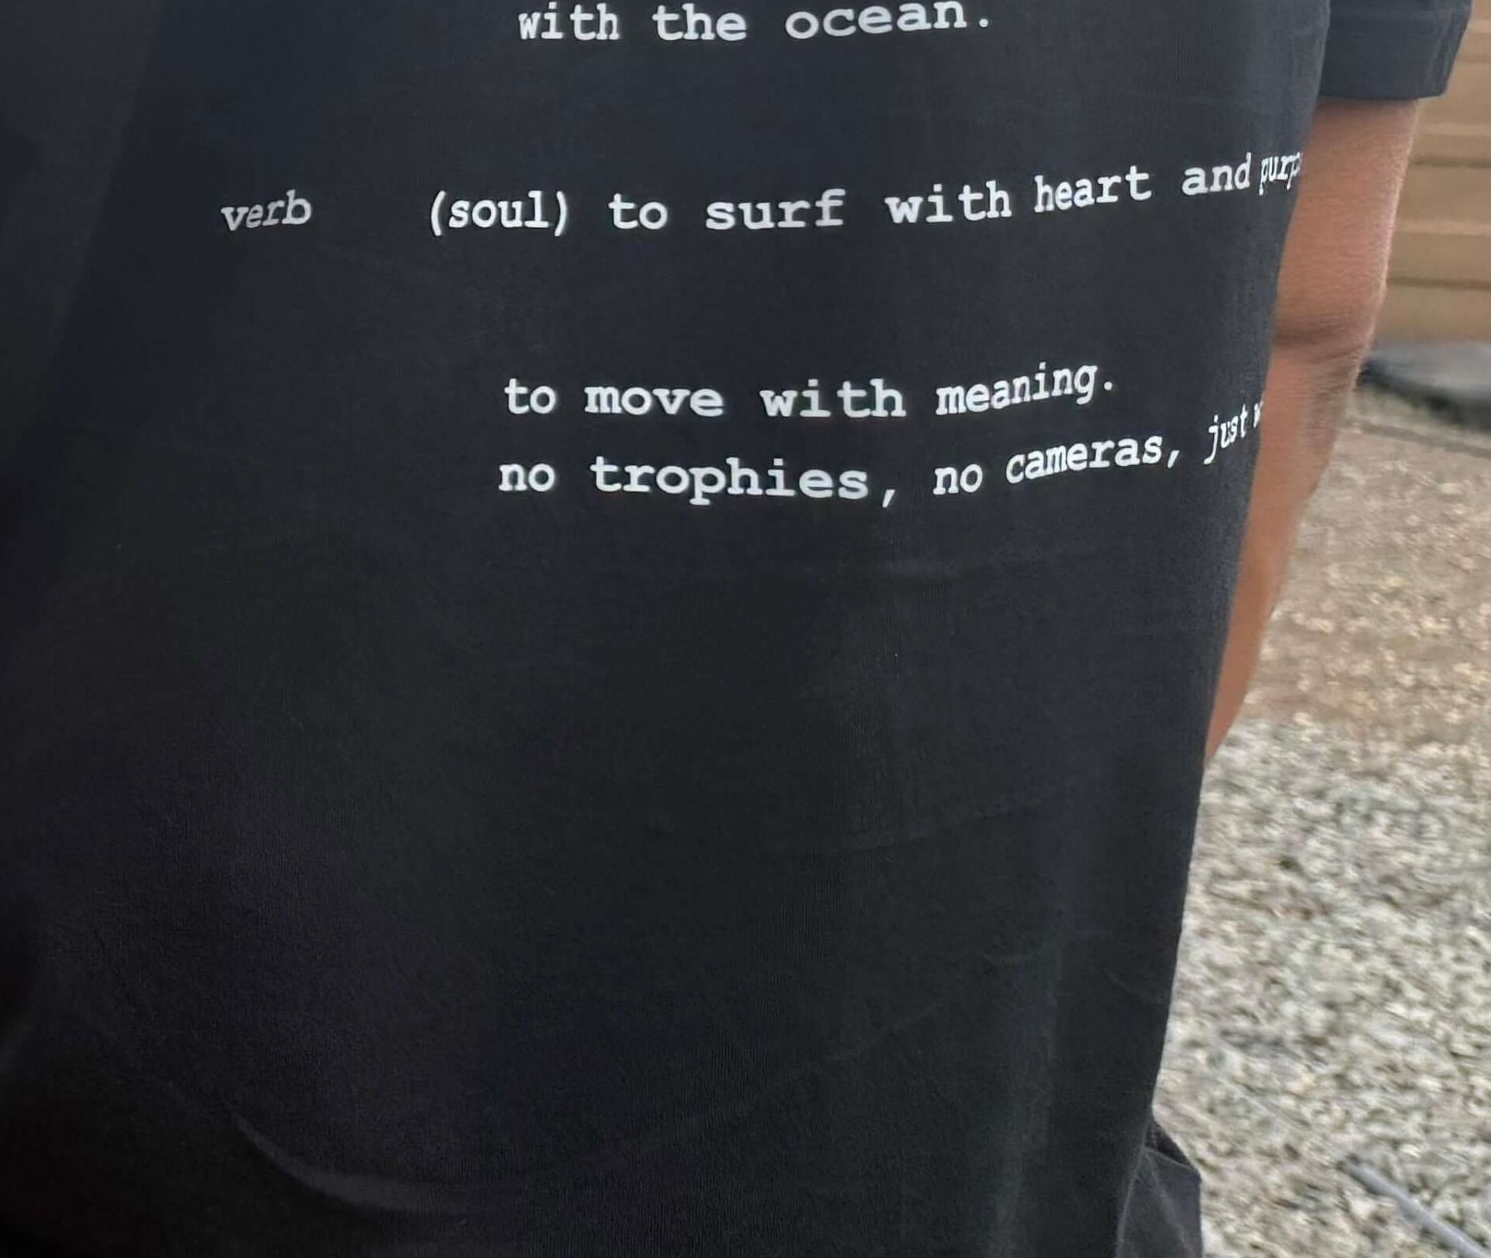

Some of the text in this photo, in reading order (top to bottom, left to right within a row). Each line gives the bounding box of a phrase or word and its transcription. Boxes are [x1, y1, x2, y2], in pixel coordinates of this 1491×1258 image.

[517, 0, 989, 42] with the ocean.
[220, 188, 313, 232] verb
[430, 189, 569, 237] (soul)
[607, 192, 669, 231] to
[705, 187, 847, 231] surf
[883, 179, 1013, 224] with
[1033, 164, 1153, 214] heart
[1181, 151, 1252, 196] and
[503, 361, 1114, 419] to move with meaning.
[497, 462, 558, 493] no
[589, 455, 896, 509] trophies,
[932, 463, 984, 496] no
[1005, 435, 1180, 485] cameras,
[1203, 403, 1249, 465] just
